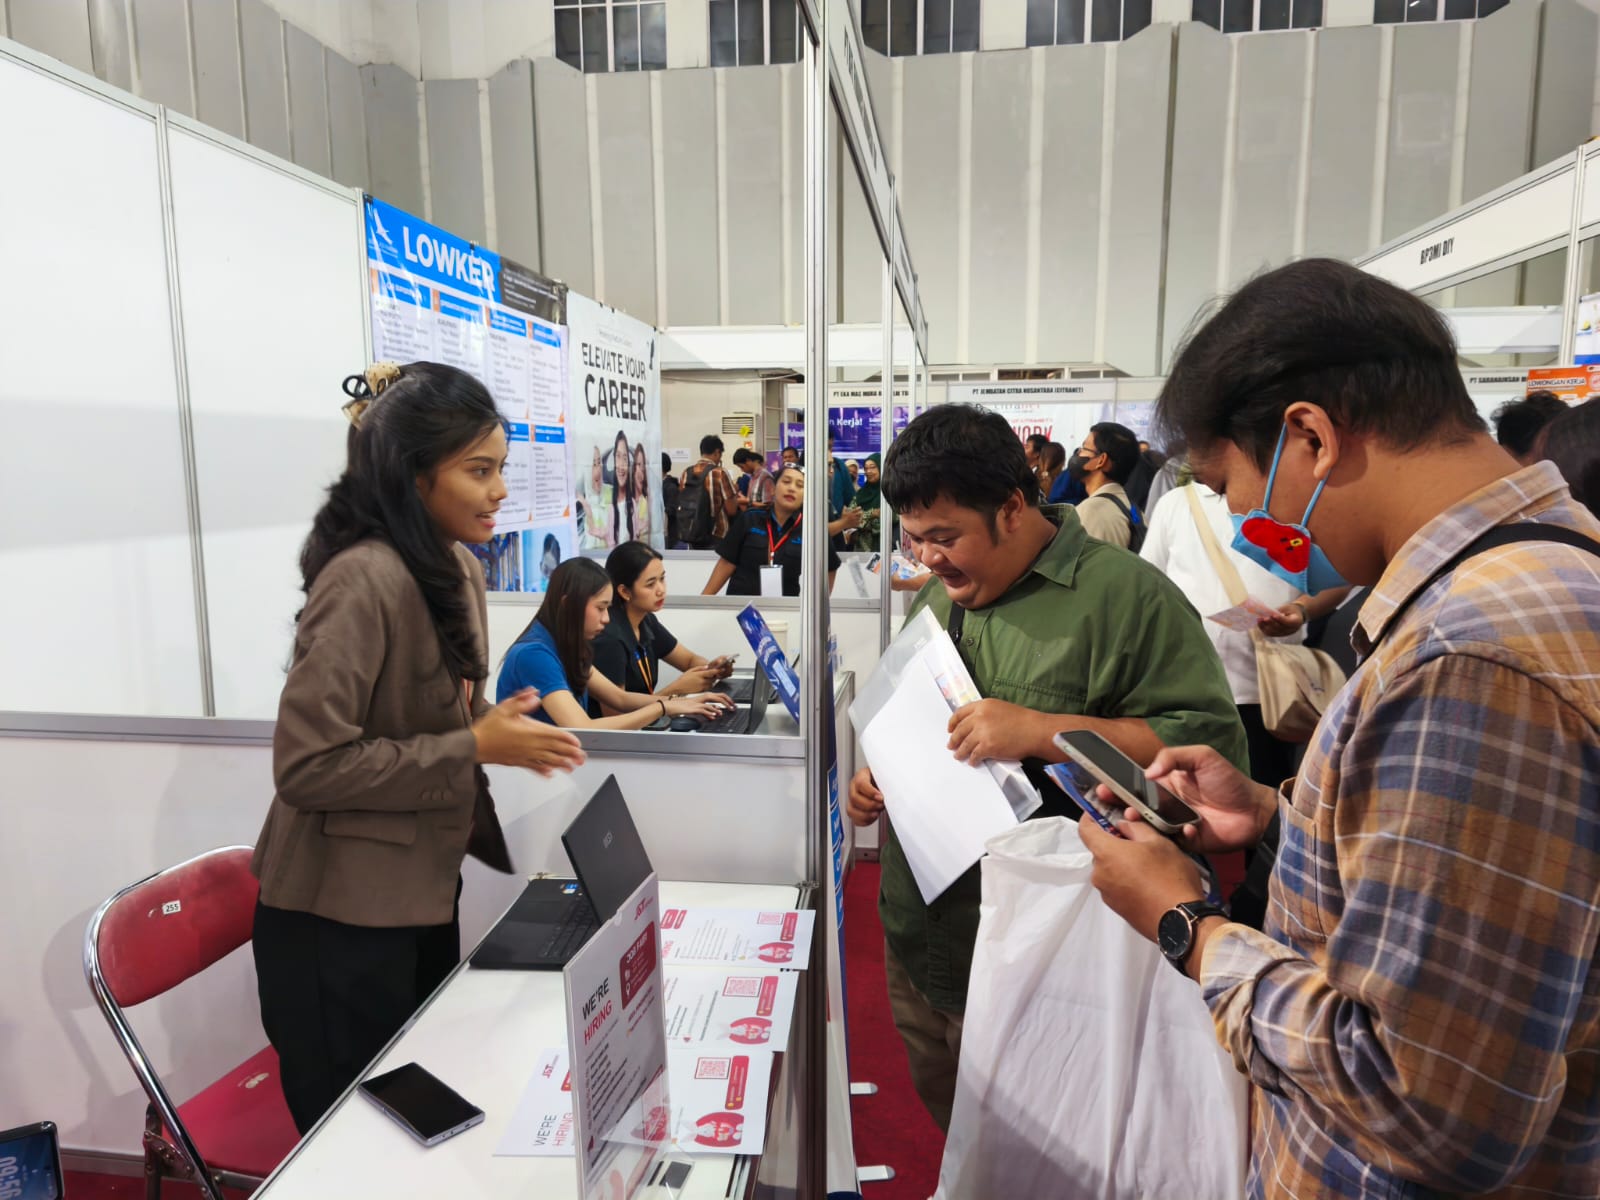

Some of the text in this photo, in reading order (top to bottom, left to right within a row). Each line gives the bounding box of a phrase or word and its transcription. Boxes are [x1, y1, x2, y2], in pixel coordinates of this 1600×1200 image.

[403, 226, 495, 292] LOWKER
[1442, 237, 1455, 256] DIY
[581, 342, 646, 380] ELEVATE YOUR
[585, 373, 647, 422] CAREER
[1528, 379, 1565, 387] LOWONGAN
[836, 416, 863, 428] Kerja!
[166, 903, 179, 913] 255
[582, 976, 610, 1020] WE'RE
[584, 999, 613, 1046] HIRING
[533, 1114, 557, 1146] WE'RE
[552, 1112, 574, 1147] HIRING
